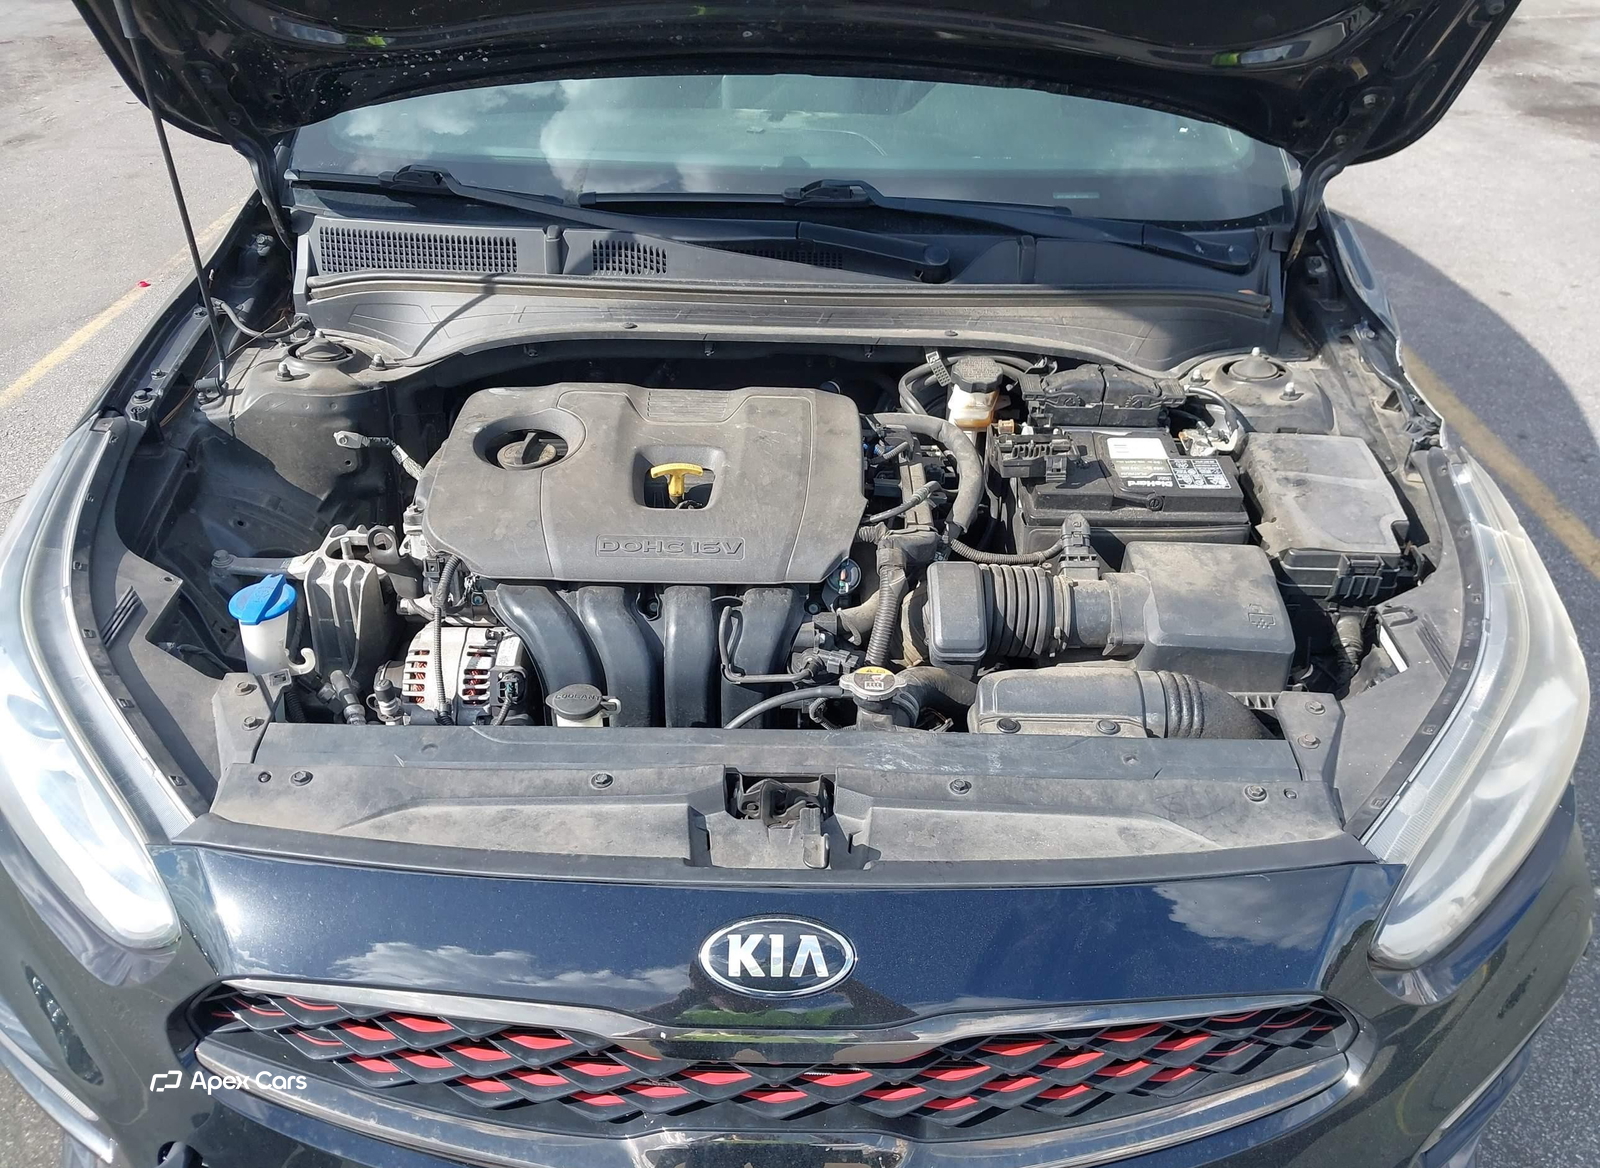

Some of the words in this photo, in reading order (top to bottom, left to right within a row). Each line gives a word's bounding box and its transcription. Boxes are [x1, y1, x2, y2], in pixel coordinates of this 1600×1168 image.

[598, 540, 684, 554] DOHC
[691, 541, 743, 555] 16V
[555, 693, 600, 701] COOLANT
[727, 934, 829, 978] KIA
